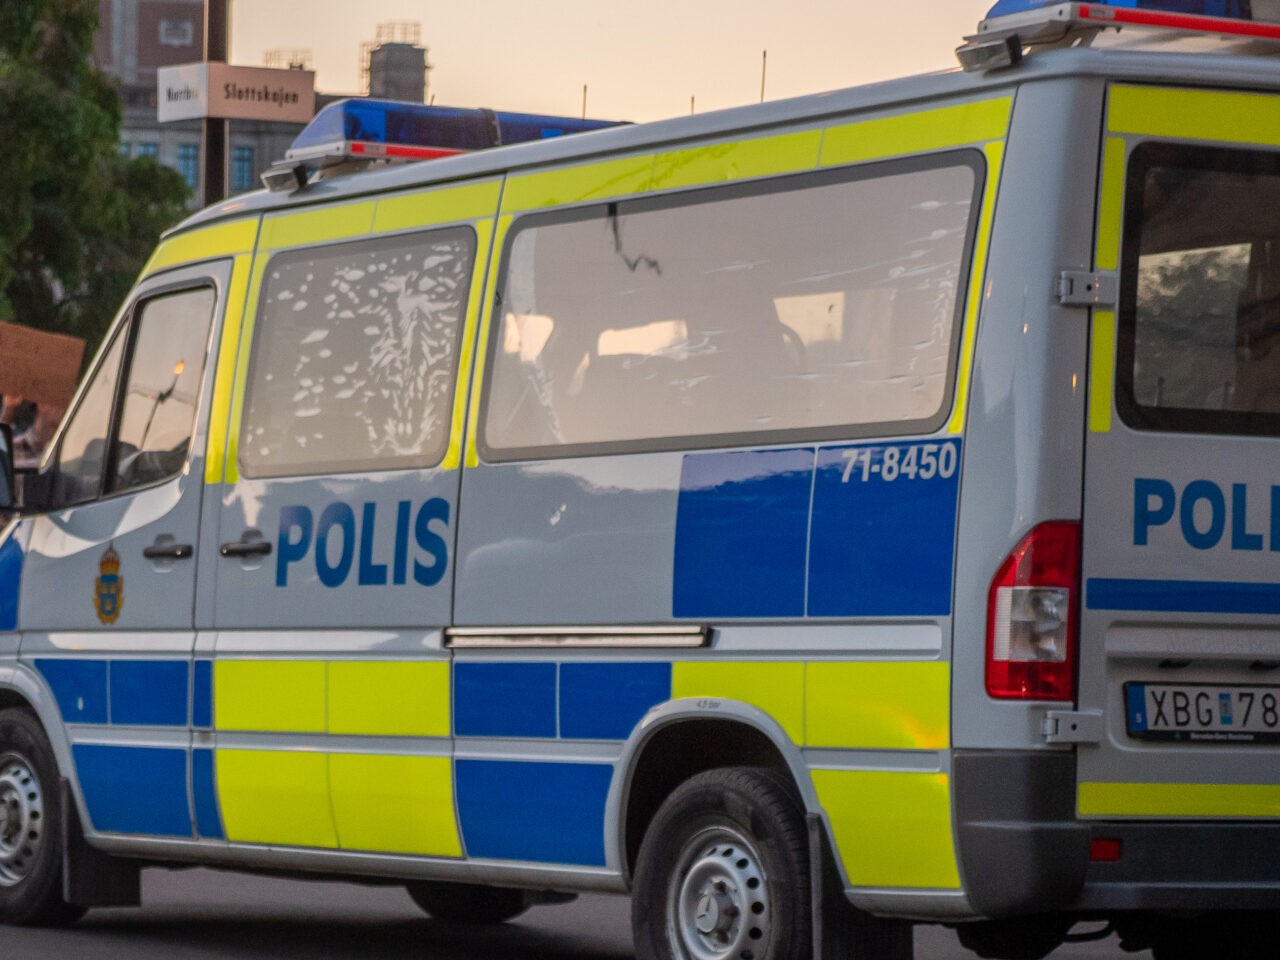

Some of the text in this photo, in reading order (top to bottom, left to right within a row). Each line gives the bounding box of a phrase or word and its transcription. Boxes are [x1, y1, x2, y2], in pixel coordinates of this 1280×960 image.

[224, 83, 299, 107] Slottskajen
[841, 441, 957, 484] 71-8450
[275, 496, 451, 589] POLIS
[1151, 690, 1279, 728] XBG 78
